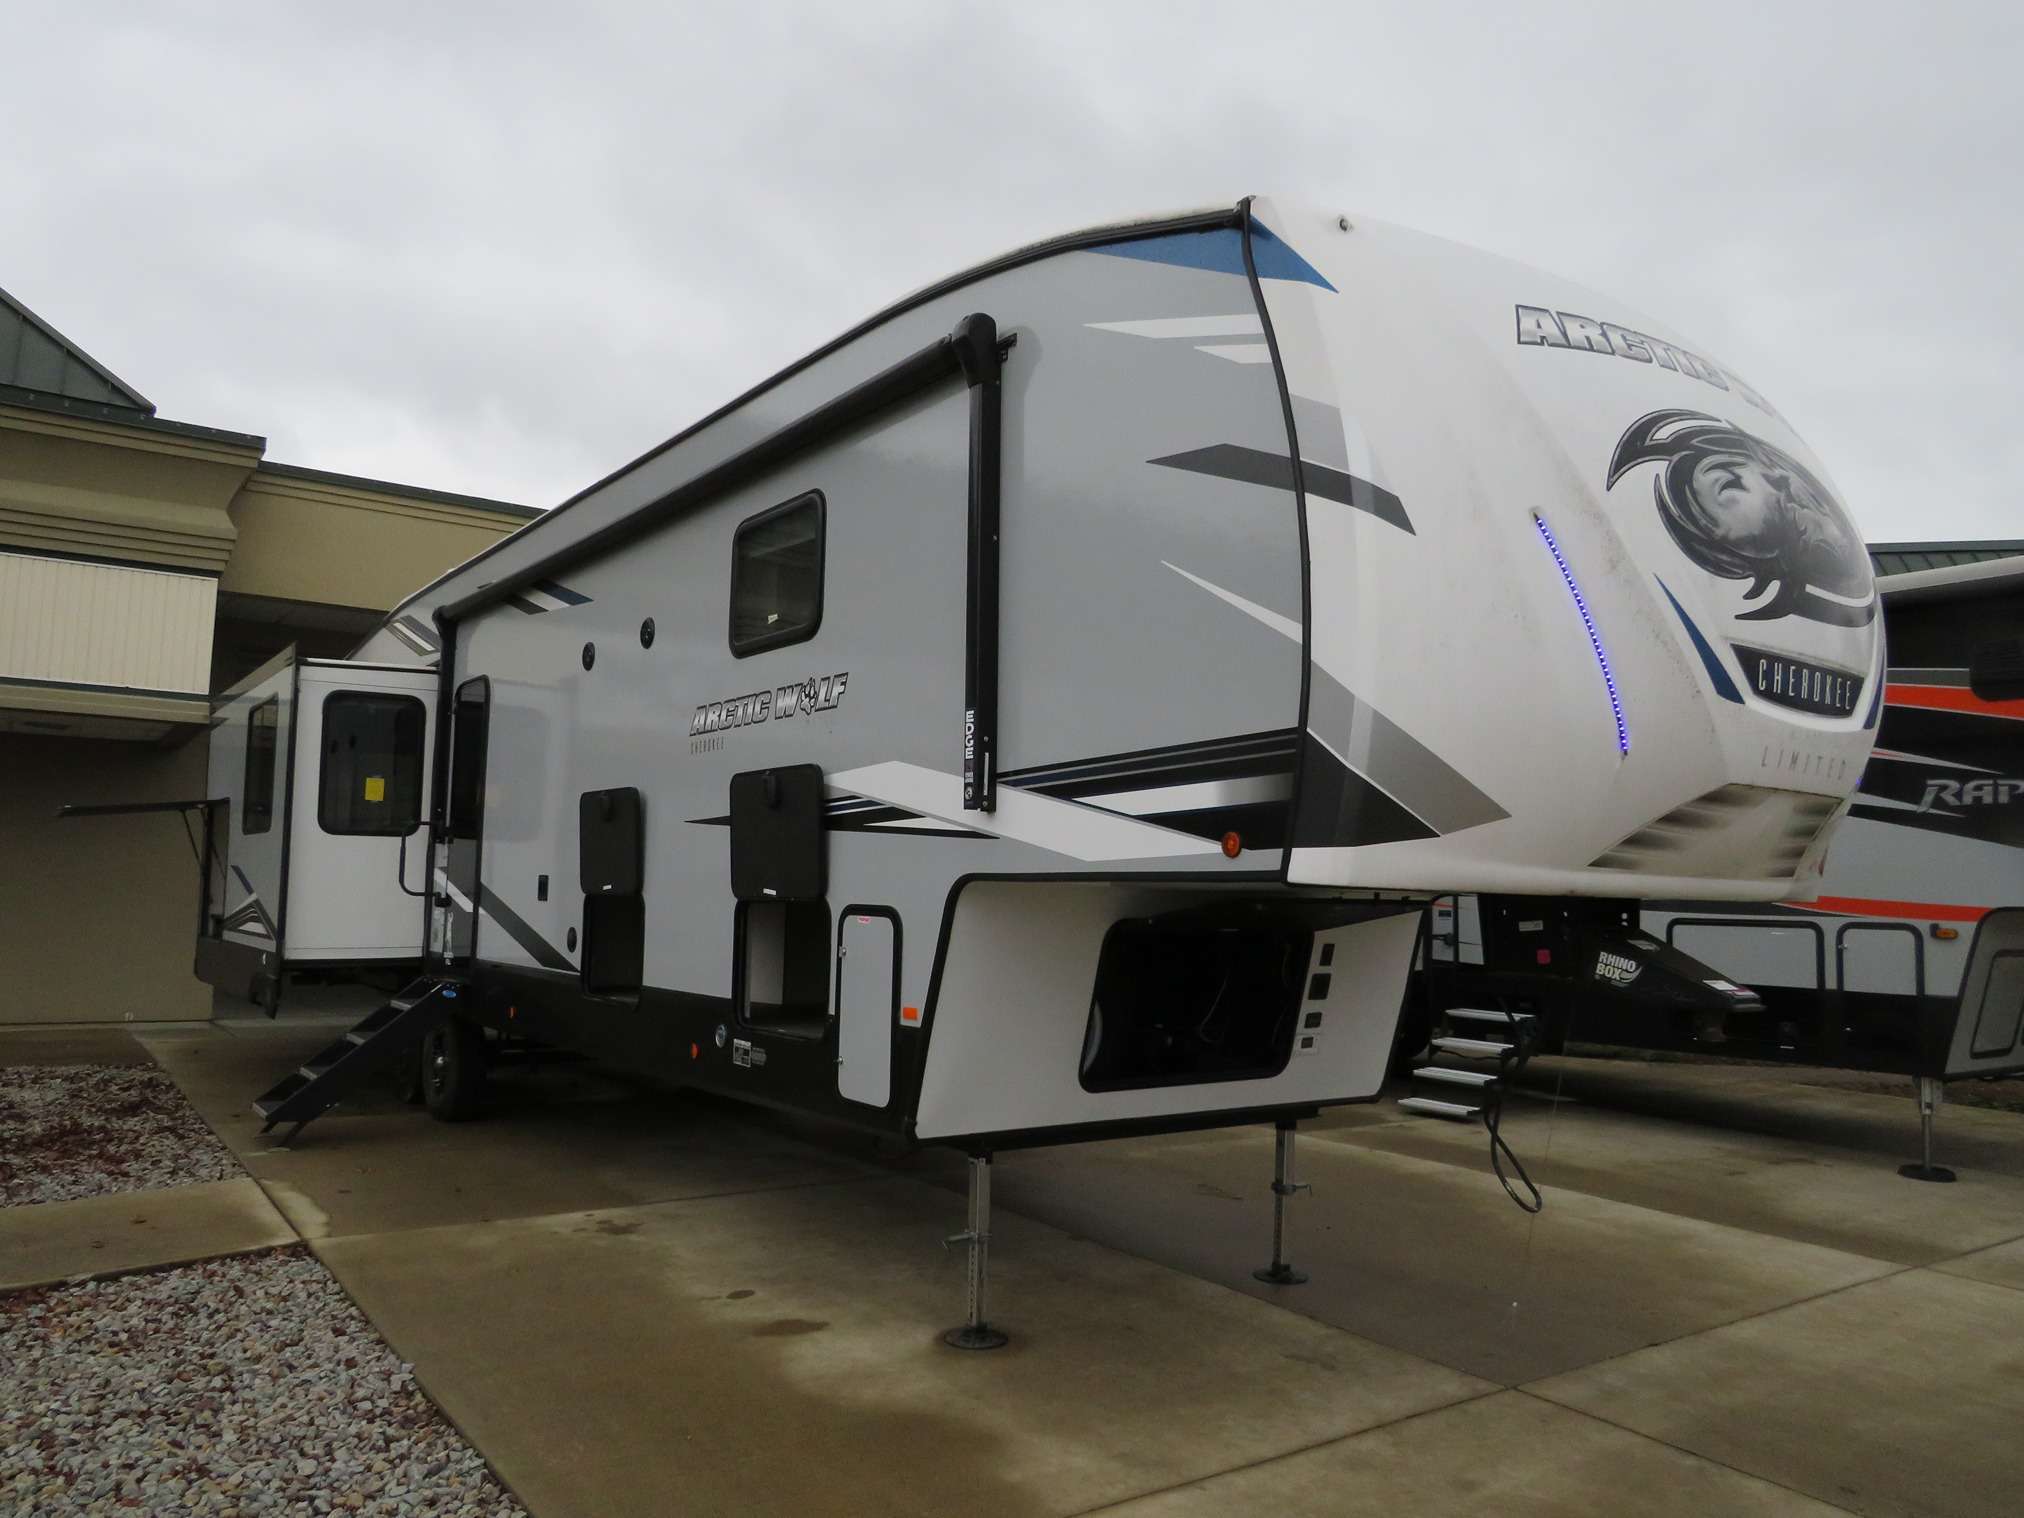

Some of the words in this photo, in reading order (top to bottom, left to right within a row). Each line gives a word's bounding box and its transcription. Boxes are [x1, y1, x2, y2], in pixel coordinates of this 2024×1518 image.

[1758, 658, 1851, 710] CHEROKEE
[689, 690, 772, 737] ARCTIC
[1595, 962, 1623, 981] BOX
[1598, 951, 1636, 972] RHINO
